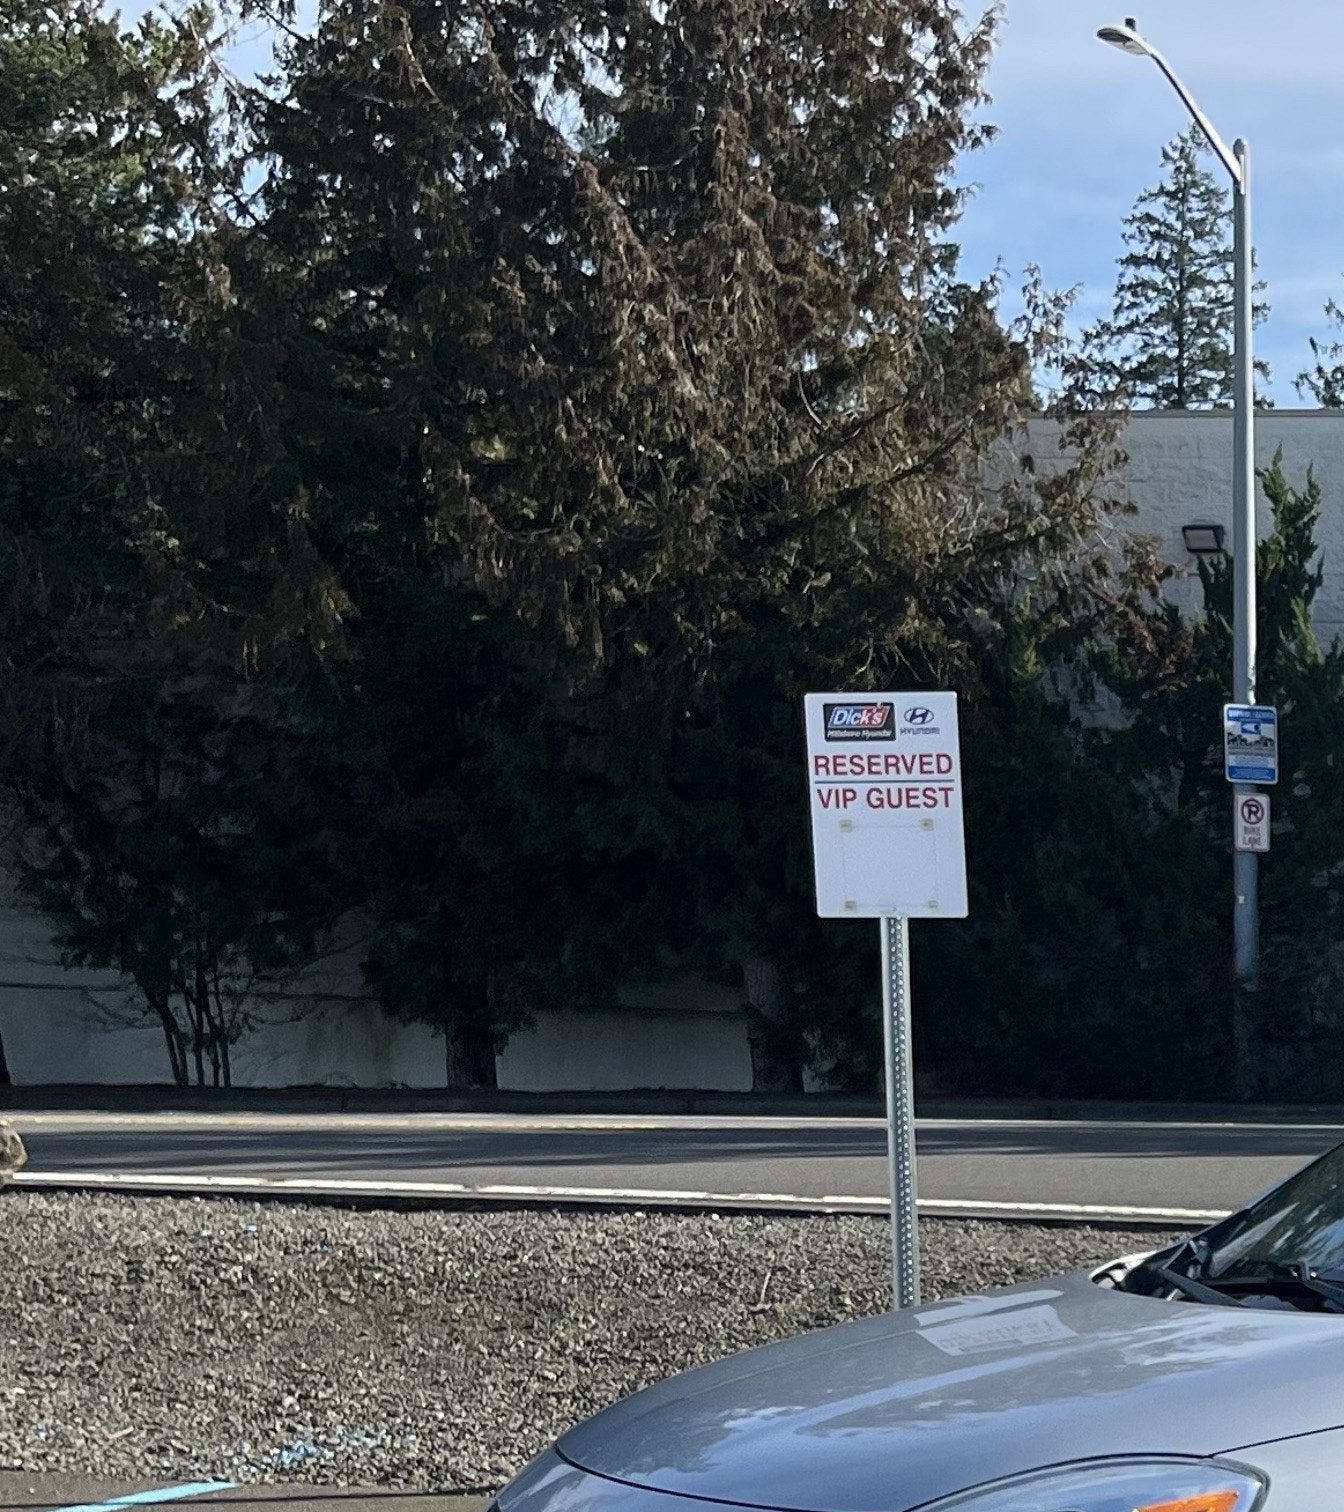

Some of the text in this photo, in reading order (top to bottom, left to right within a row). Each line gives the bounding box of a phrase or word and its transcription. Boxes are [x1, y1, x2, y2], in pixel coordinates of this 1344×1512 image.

[814, 753, 953, 776] RESERVED
[817, 787, 954, 809] VIP GUEST
